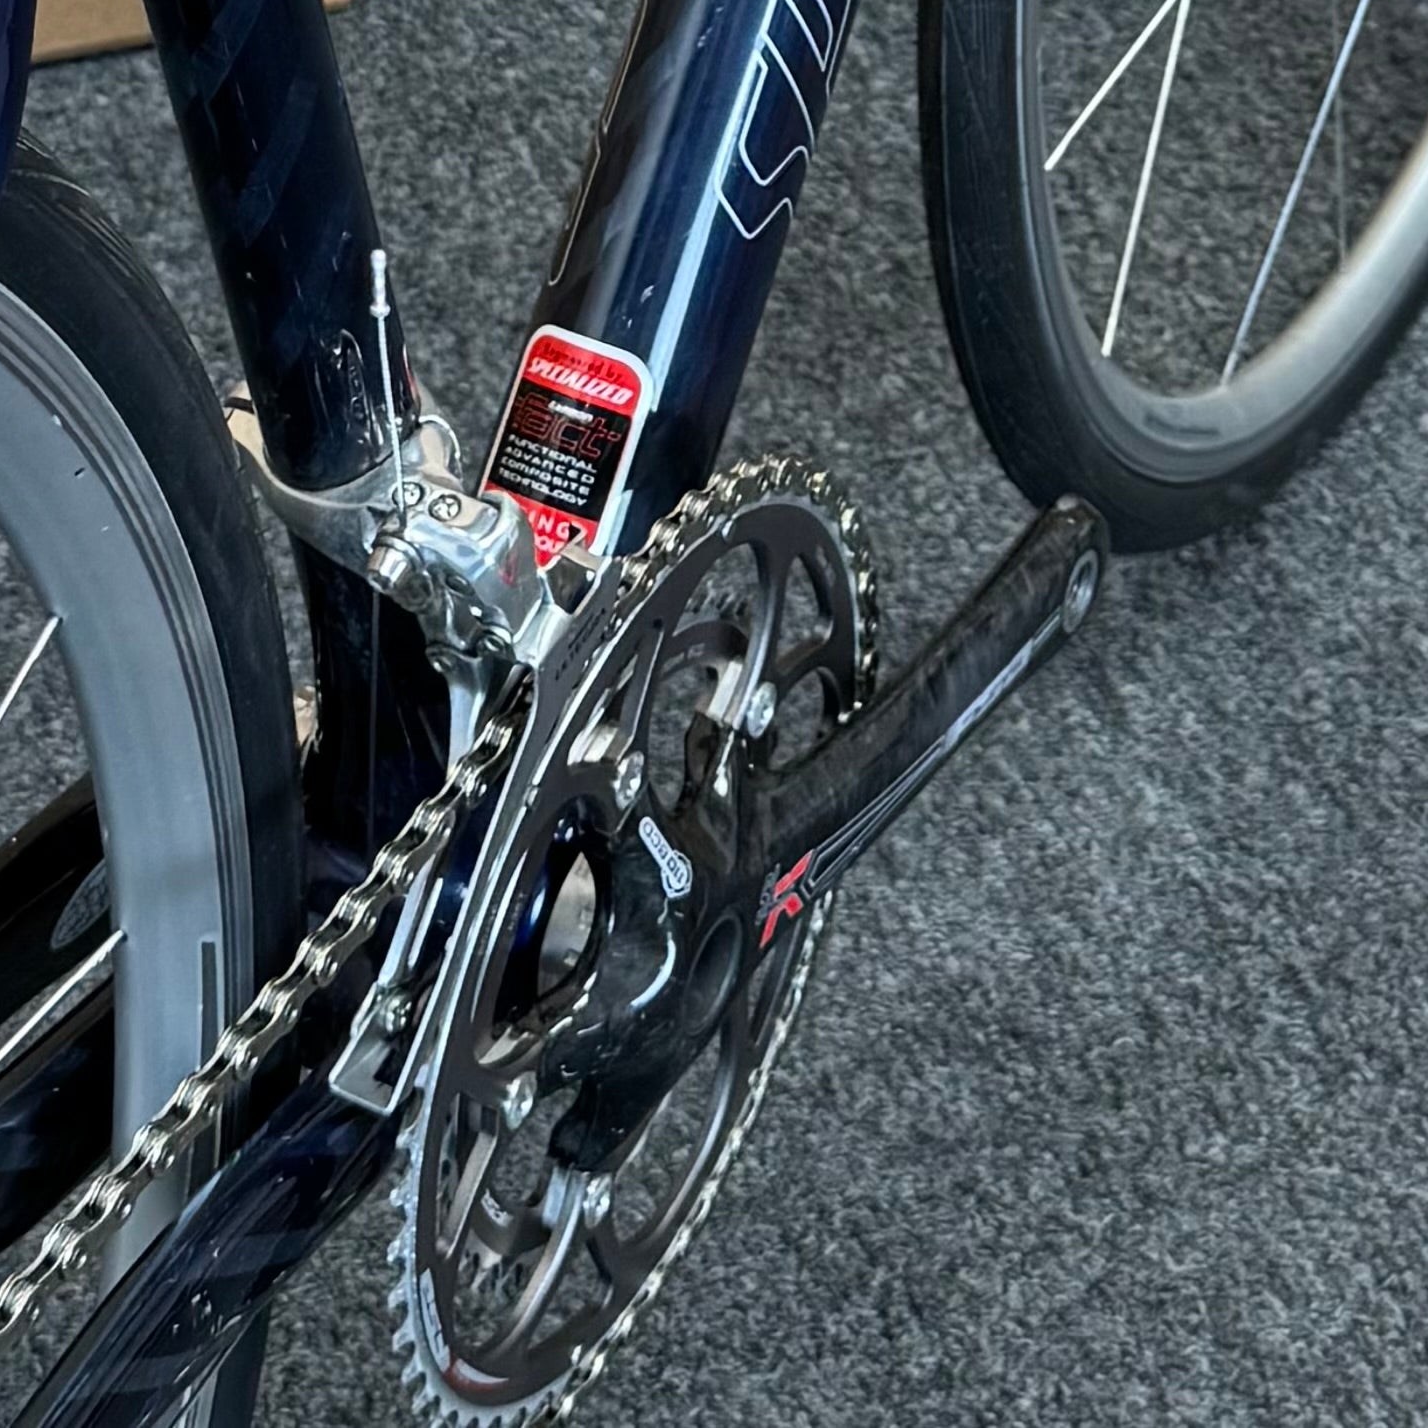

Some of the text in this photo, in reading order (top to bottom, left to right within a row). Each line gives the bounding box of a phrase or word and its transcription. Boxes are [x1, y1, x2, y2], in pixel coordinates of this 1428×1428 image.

[527, 357, 634, 406] SPECIALIZED
[504, 445, 595, 485] ADVANCED
[508, 434, 598, 474] FUNCTIONAL
[498, 466, 588, 506] TECHNOLOGY
[501, 456, 592, 496] COMPOSITE
